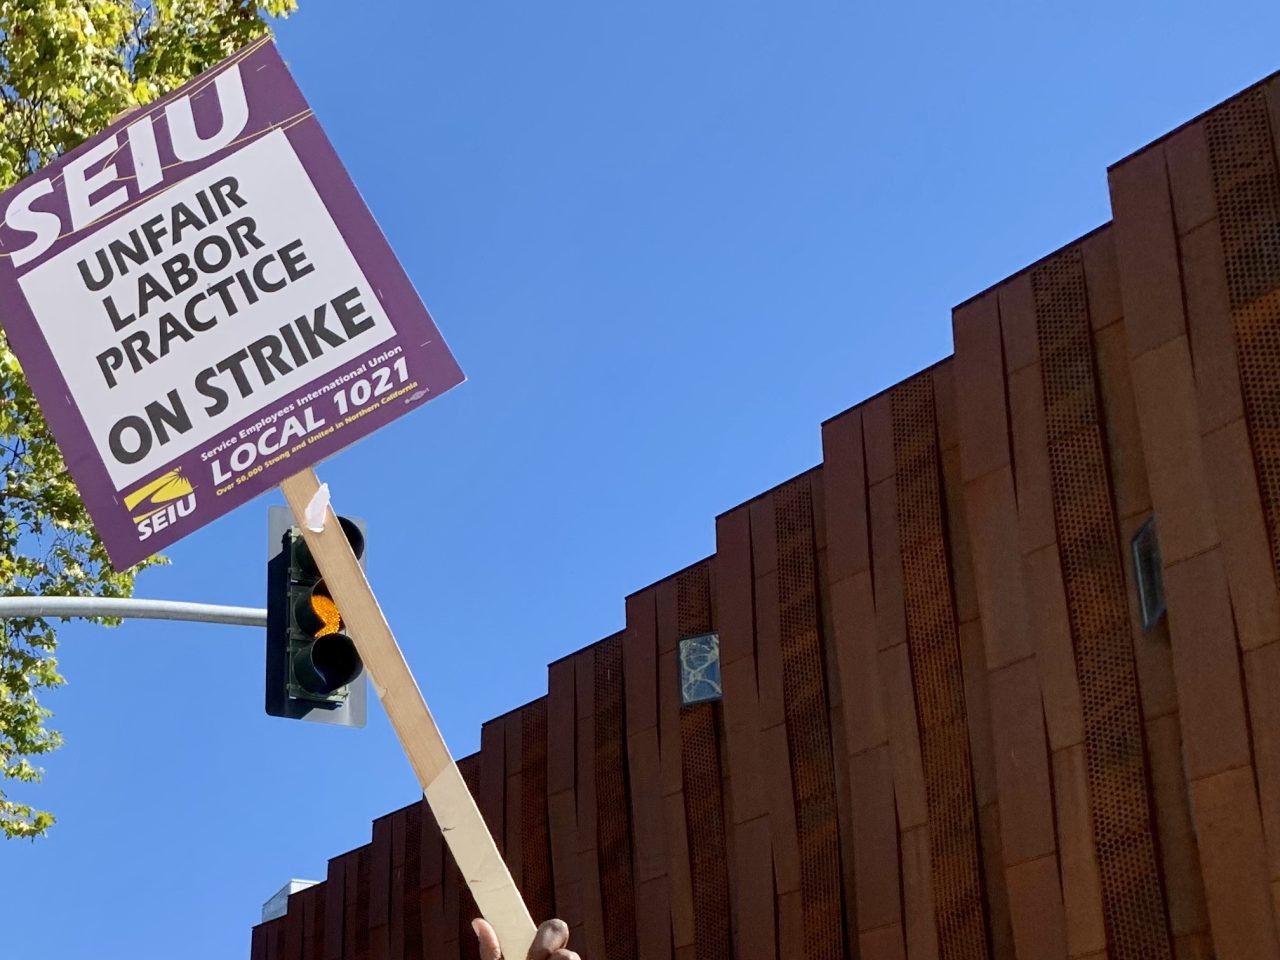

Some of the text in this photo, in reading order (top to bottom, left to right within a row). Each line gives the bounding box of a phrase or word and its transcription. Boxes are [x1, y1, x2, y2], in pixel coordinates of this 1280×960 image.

[5, 64, 250, 268] SEIU
[77, 176, 248, 292] UNFAIR
[102, 216, 265, 332] LABOR
[96, 239, 316, 389] PRACTICE
[108, 287, 377, 465] ON STRIKE
[201, 346, 403, 462] Service Employees International Union
[211, 356, 410, 486] LOCAL 1021
[216, 380, 418, 497] Over 50,000 Strong and United in Northern California
[137, 493, 198, 542] SEIU
